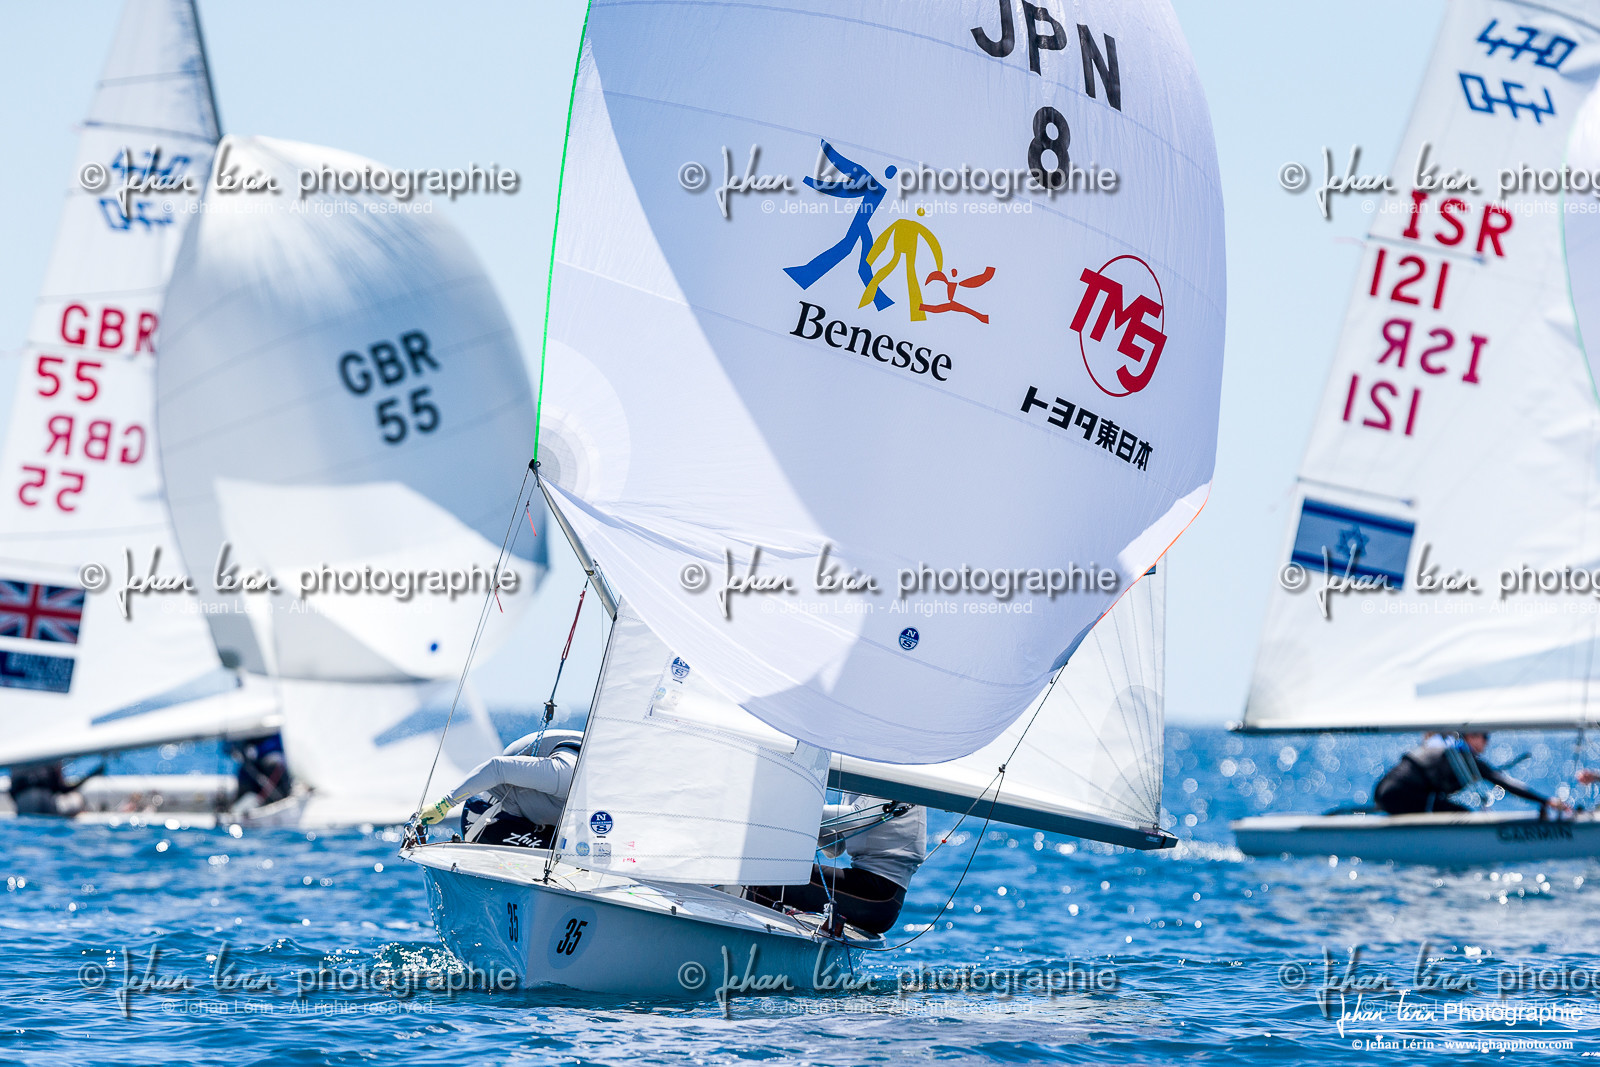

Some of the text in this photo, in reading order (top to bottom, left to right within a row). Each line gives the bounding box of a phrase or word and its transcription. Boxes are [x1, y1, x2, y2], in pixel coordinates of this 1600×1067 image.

[970, 0, 1122, 112] JPN
[1028, 106, 1070, 190] 8
[1403, 190, 1514, 257] ISR
[1369, 249, 1449, 310] 121
[61, 303, 158, 354] GBR
[789, 300, 952, 381] Benesse
[37, 356, 103, 401] 55
[339, 329, 440, 397] GBR
[375, 387, 440, 445] 55
[1020, 385, 1153, 471] トヨタ東日本
[507, 902, 519, 943] 35
[556, 918, 589, 955] 35
